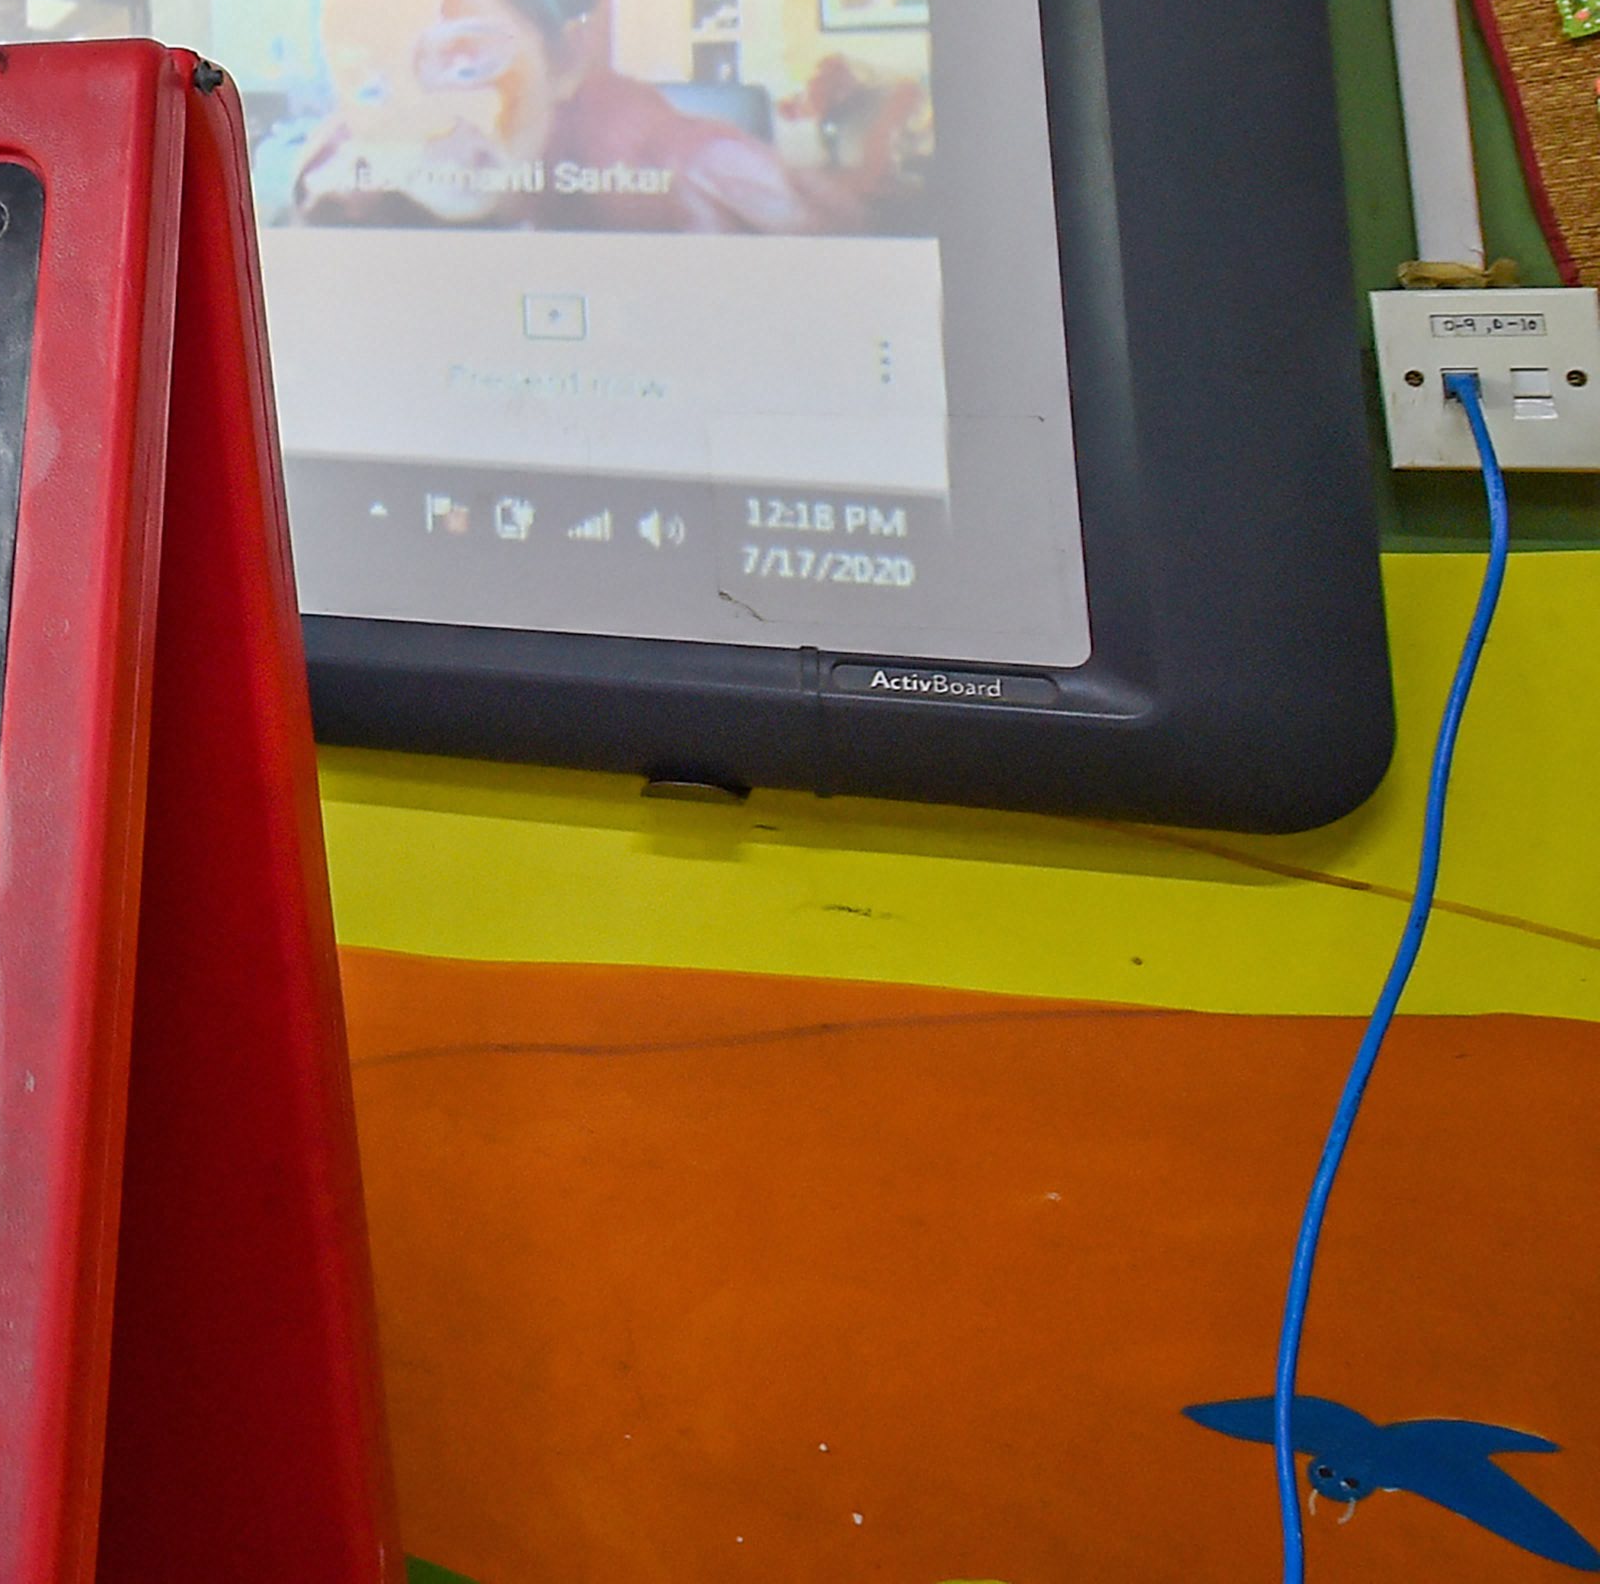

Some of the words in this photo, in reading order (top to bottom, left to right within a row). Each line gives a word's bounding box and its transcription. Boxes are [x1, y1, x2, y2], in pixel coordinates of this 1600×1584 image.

[553, 160, 674, 196] Sarkar
[745, 497, 835, 532] 12:18
[844, 503, 908, 538] PM
[741, 545, 916, 588] 7/17/2020
[869, 667, 1003, 701] ActivBoard
